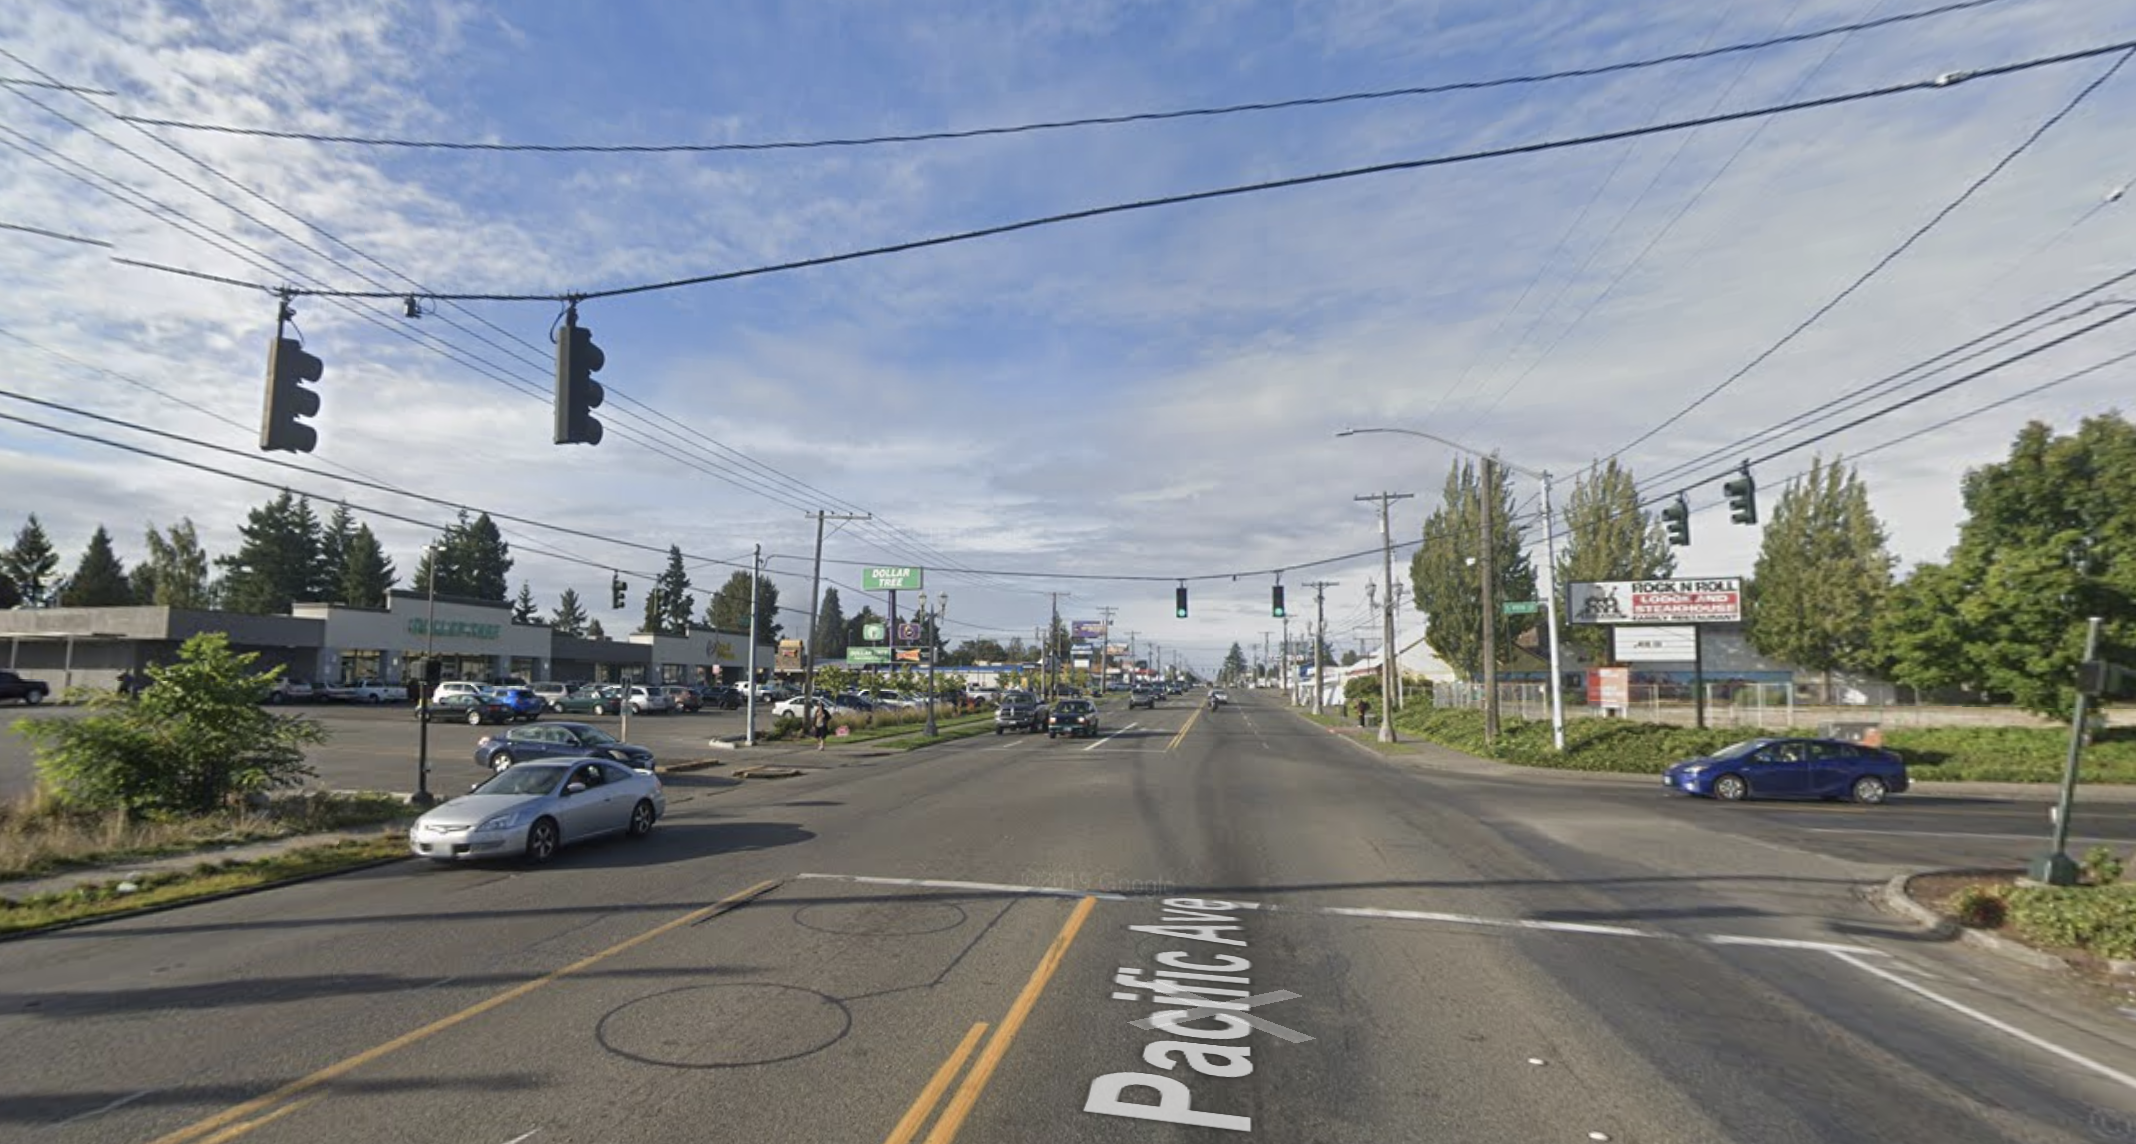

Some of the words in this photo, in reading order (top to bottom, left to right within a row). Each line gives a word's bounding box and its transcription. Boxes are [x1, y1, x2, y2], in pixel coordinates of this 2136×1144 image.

[872, 568, 911, 578] DOLLAR
[879, 578, 904, 587] TREE
[1632, 582, 1676, 593] ROCK
[1681, 581, 1692, 592] N
[1696, 581, 1737, 592] ROLL
[1694, 593, 1729, 603] AND
[1634, 604, 1737, 614] STEAKHOUSE
